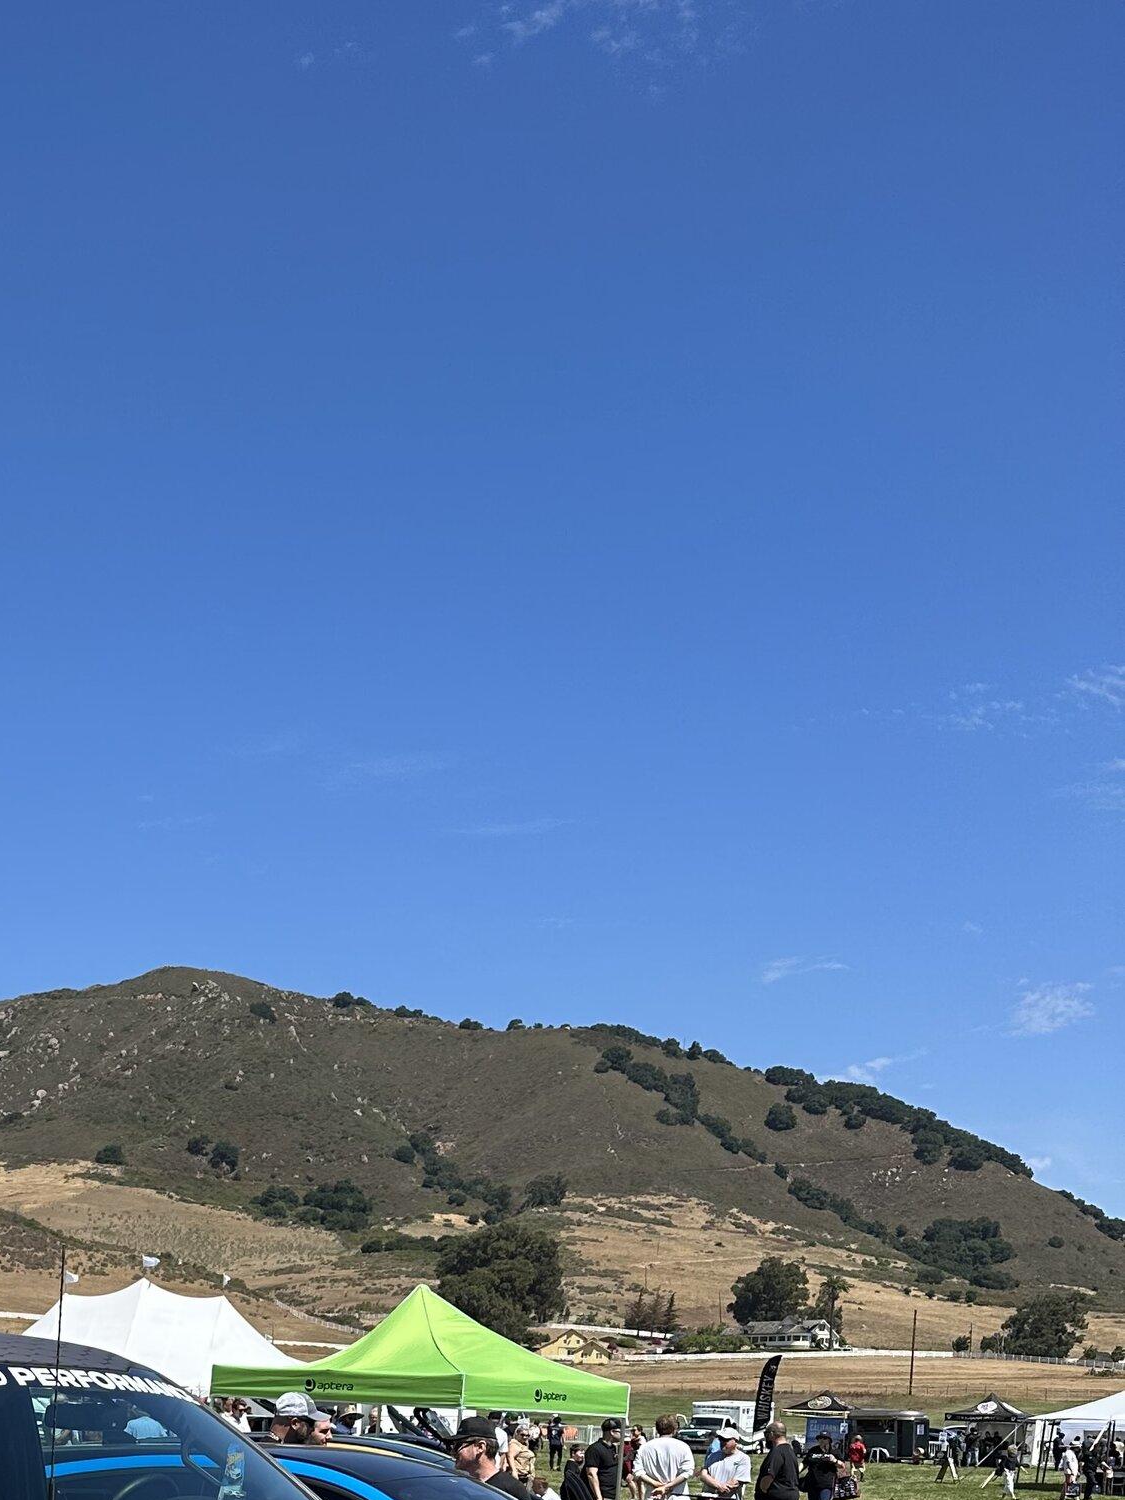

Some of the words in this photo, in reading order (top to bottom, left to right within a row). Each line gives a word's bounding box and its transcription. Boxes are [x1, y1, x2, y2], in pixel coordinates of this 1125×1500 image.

[317, 1382, 354, 1391] aptera
[543, 1392, 567, 1402] aptera
[756, 1375, 774, 1420] WHISKEY
